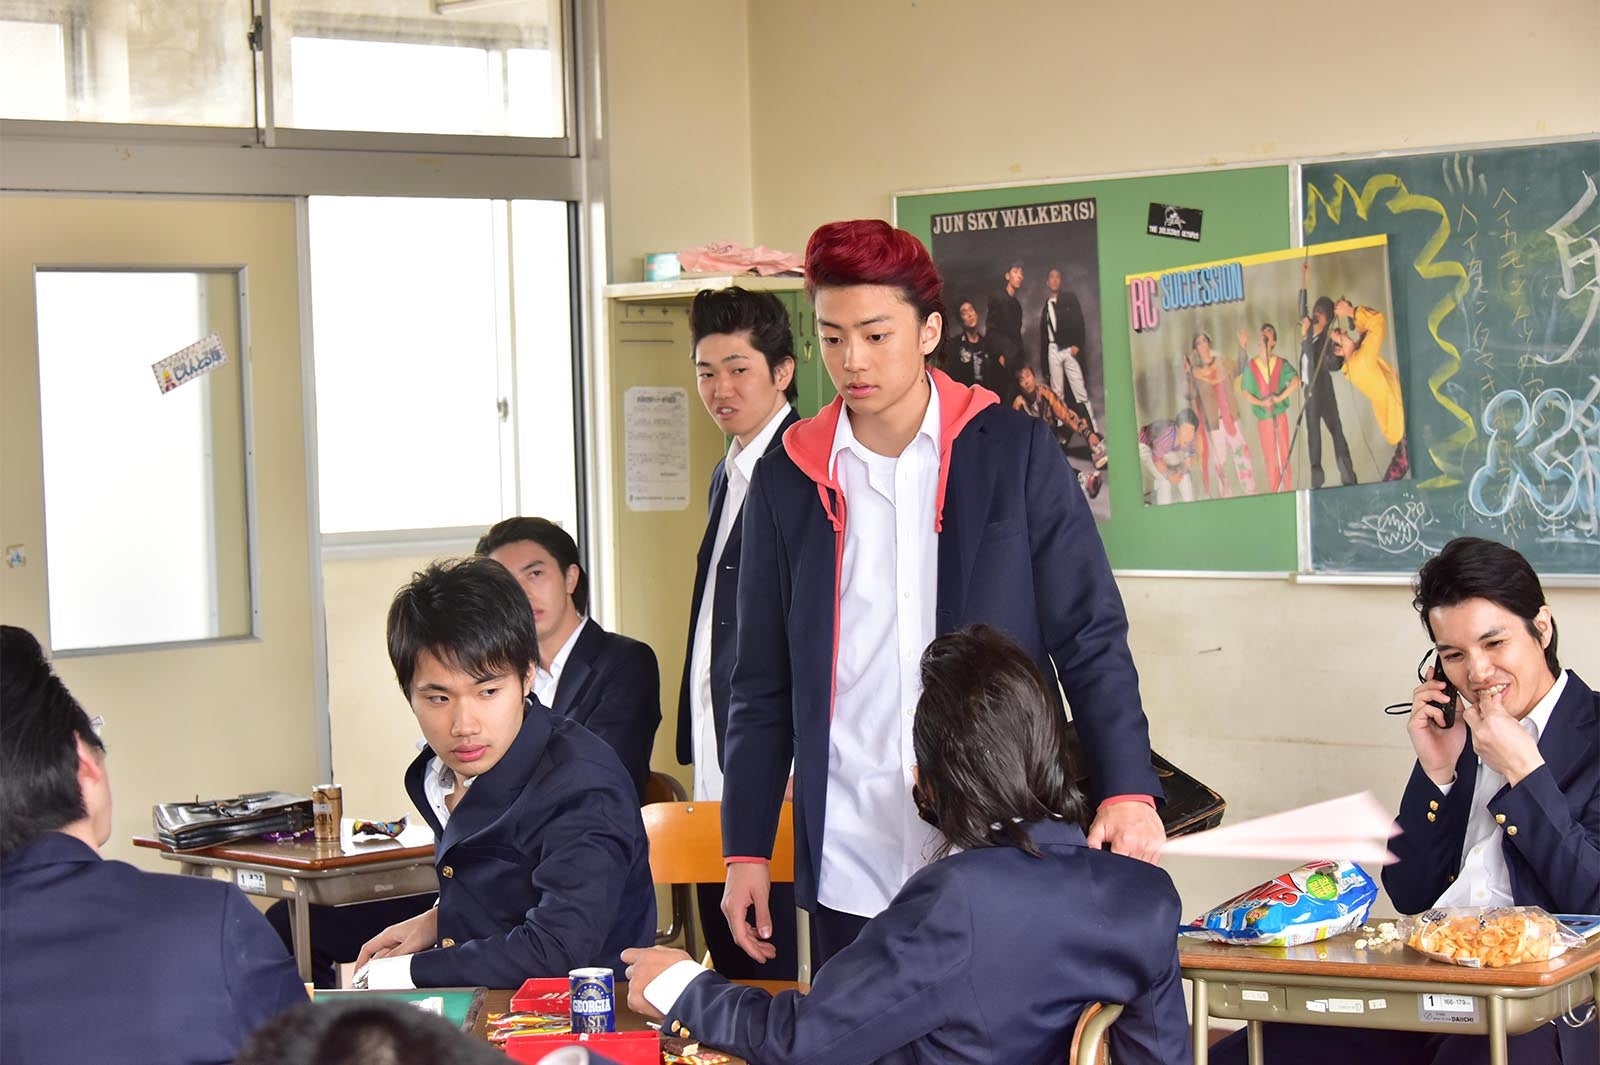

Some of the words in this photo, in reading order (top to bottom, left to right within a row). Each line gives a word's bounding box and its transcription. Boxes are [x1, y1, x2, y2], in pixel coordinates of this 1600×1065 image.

[933, 213, 964, 235] JUN
[967, 210, 998, 231] SKY
[1000, 200, 1095, 228] WALKER(S)
[1130, 276, 1159, 332] RC
[1160, 262, 1245, 311] SUCCESSION
[573, 998, 611, 1012] GEORGIA
[1428, 995, 1434, 1007] 1
[574, 1015, 608, 1028] TASTY
